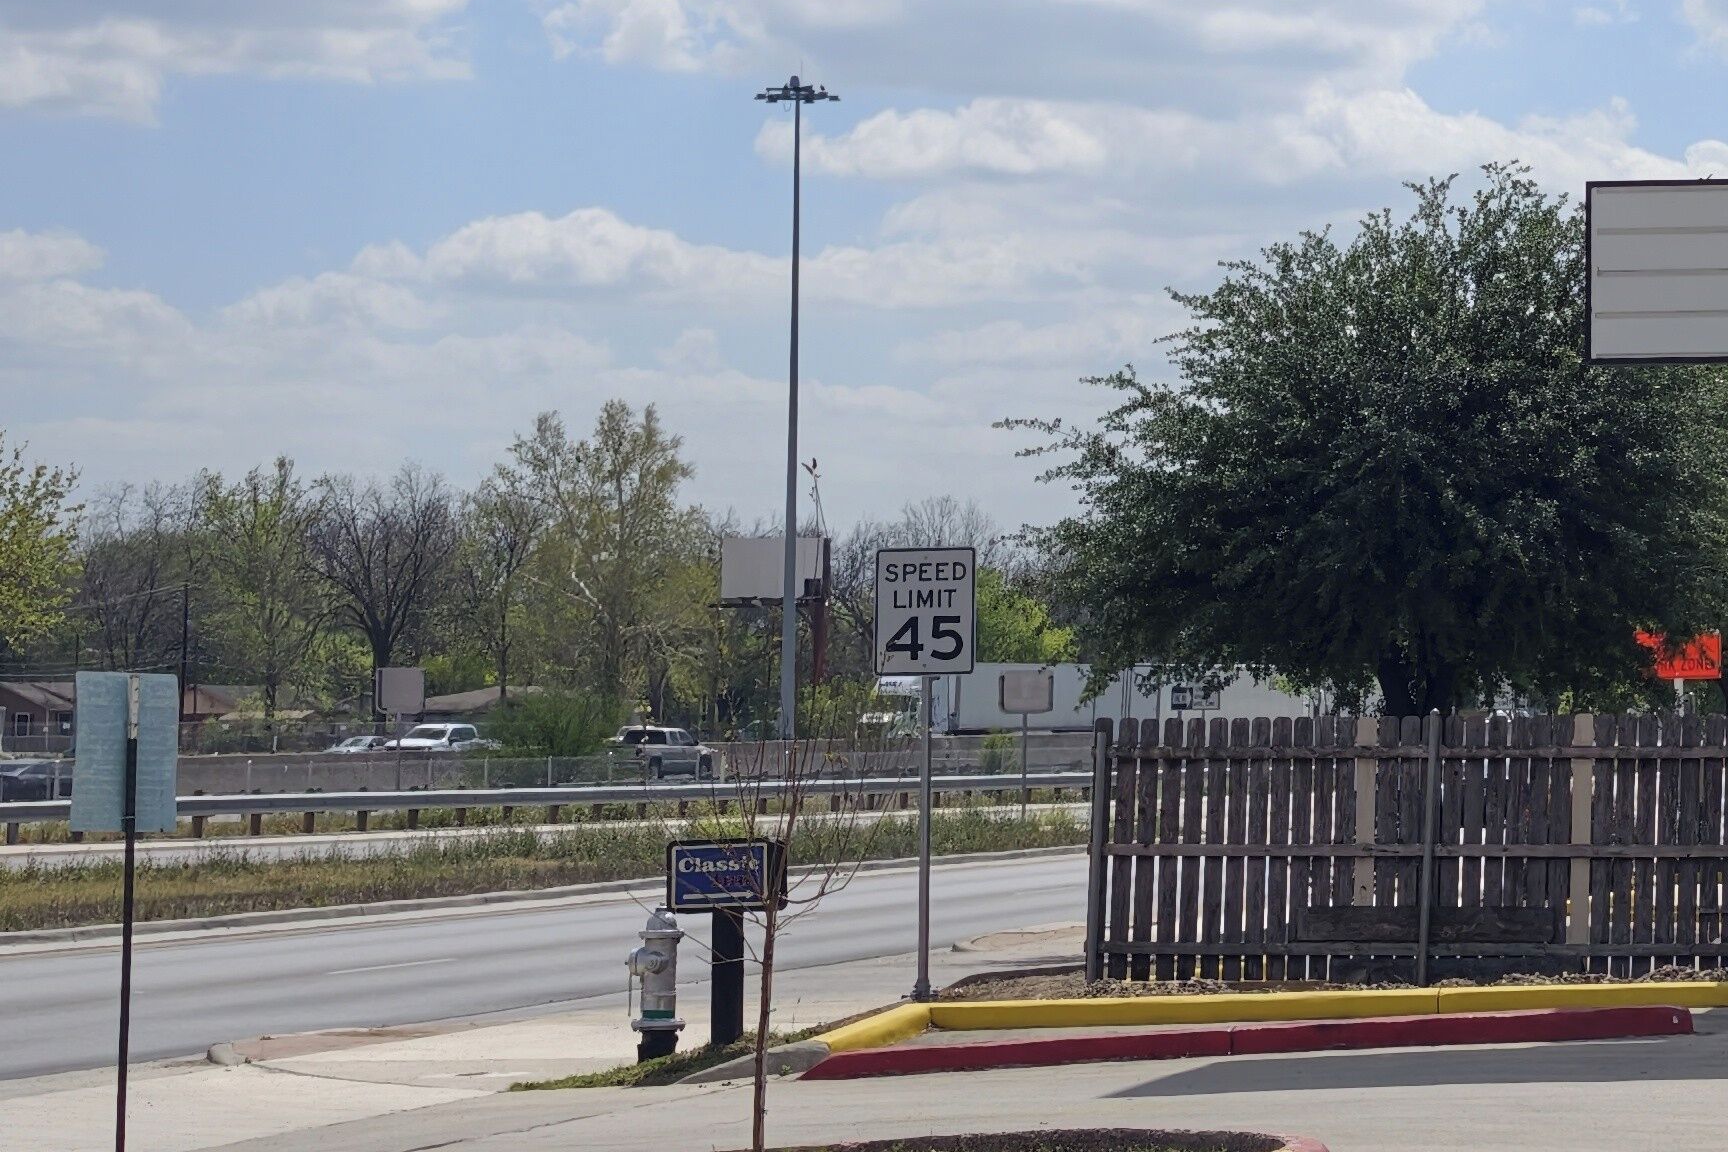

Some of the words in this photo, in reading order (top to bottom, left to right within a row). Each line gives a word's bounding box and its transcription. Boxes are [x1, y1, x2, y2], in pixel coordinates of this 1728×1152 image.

[884, 561, 967, 583] SPEED
[893, 589, 957, 609] LIMIT
[885, 615, 964, 661] 45
